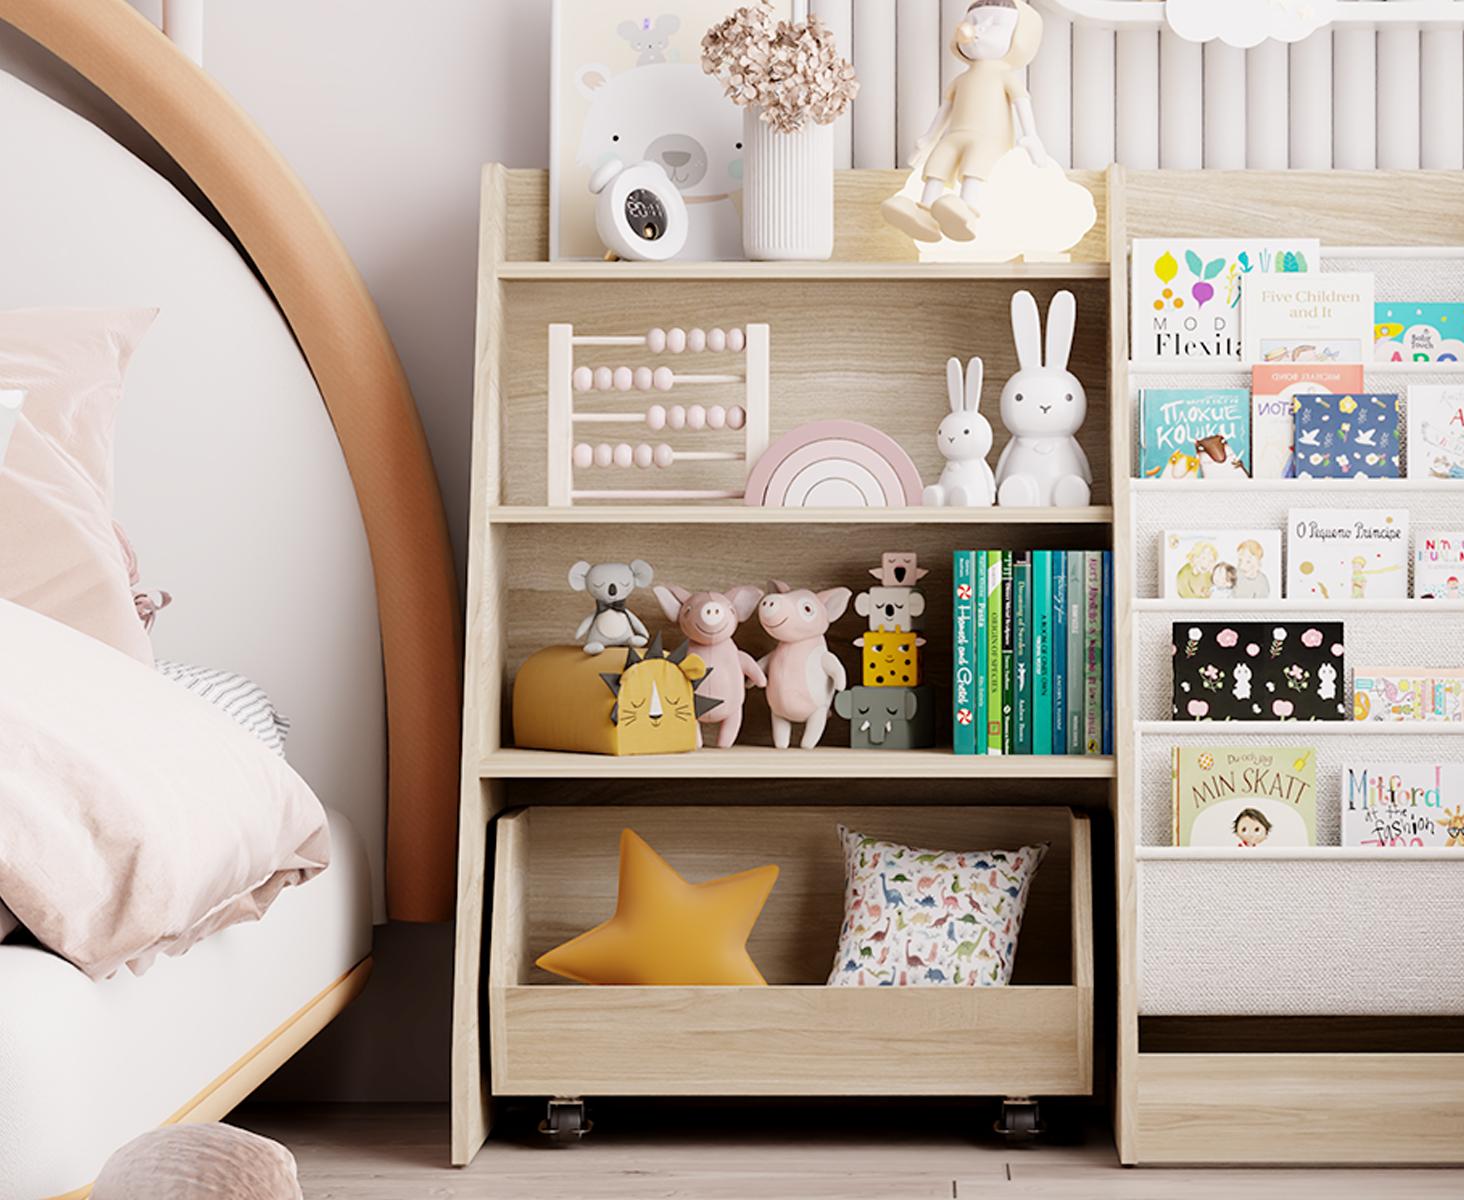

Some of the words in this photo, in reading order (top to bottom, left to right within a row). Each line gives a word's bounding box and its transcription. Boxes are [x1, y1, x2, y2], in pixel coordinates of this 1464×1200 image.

[1262, 290, 1293, 303] Five
[1295, 290, 1360, 303] Children
[1289, 306, 1318, 319] and
[1321, 306, 1333, 318] It
[1296, 521, 1307, 538] O
[1192, 771, 1236, 809] MIN
[1241, 767, 1311, 804] SKATT
[1348, 766, 1441, 810] Mitford
